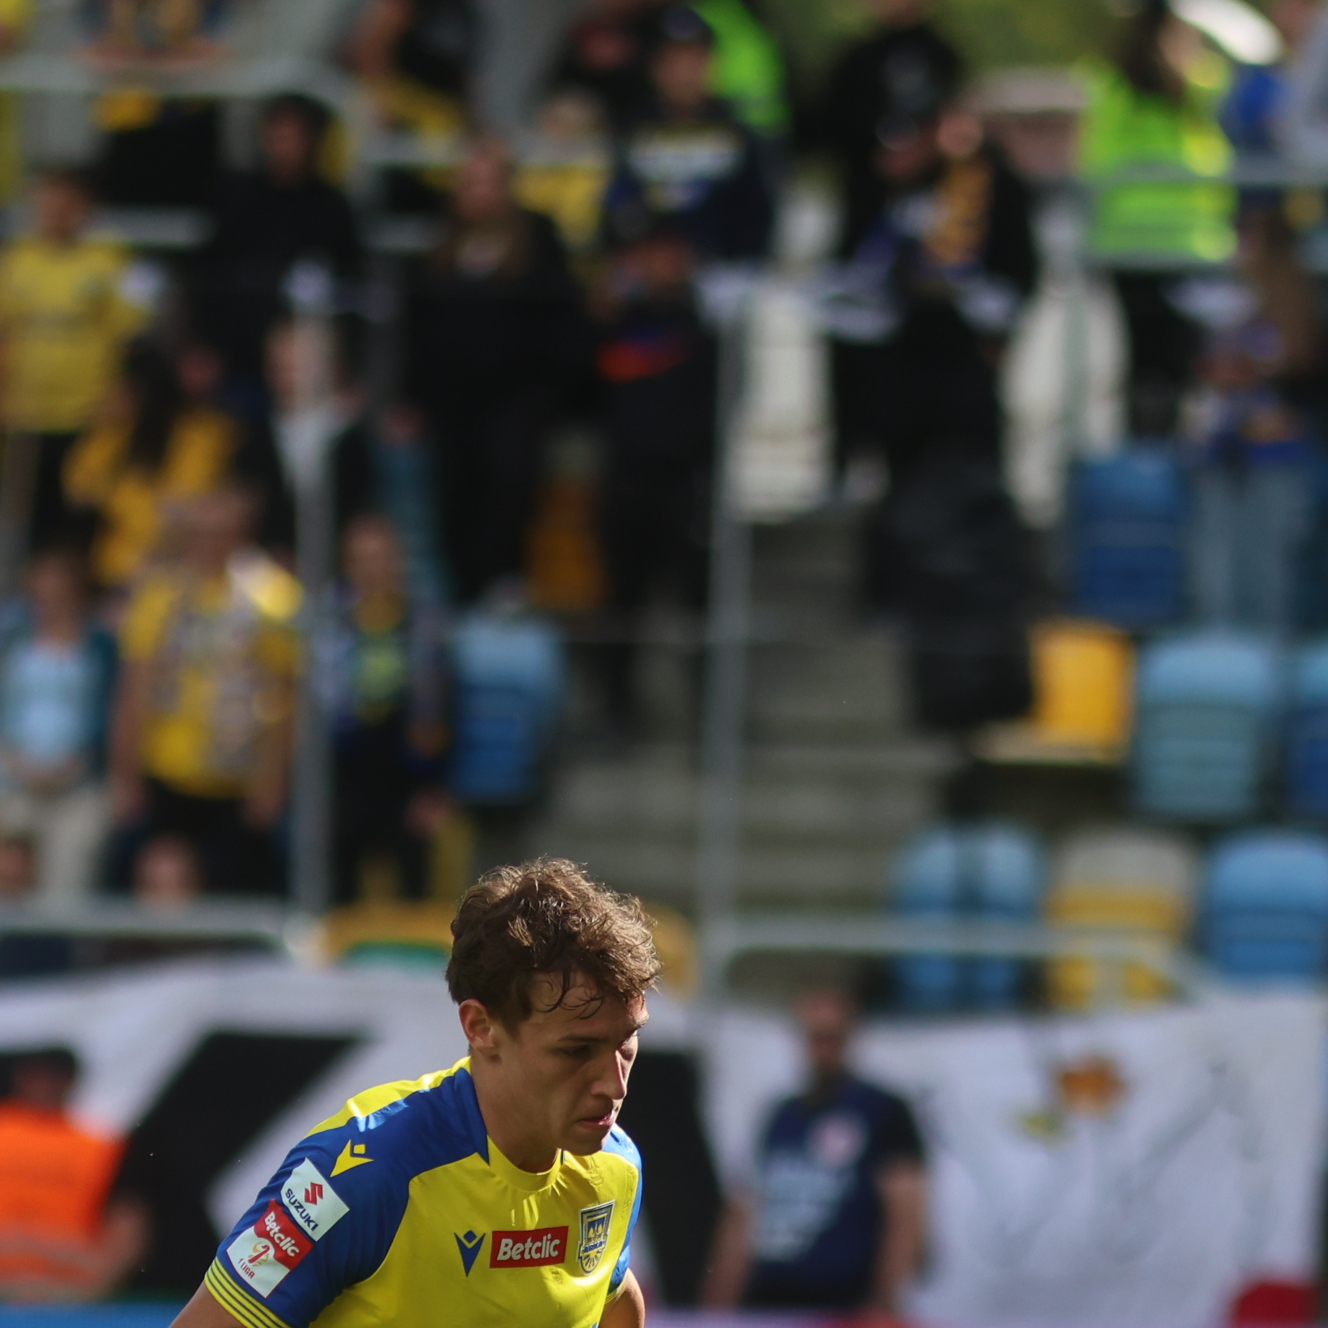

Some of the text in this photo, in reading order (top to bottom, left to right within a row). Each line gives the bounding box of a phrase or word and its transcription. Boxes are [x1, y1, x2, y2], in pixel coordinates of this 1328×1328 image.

[285, 1188, 319, 1232] SUZUKI
[264, 1210, 300, 1257] Betclic
[496, 1233, 561, 1261] Betclic
[240, 1263, 256, 1279] LIGA
